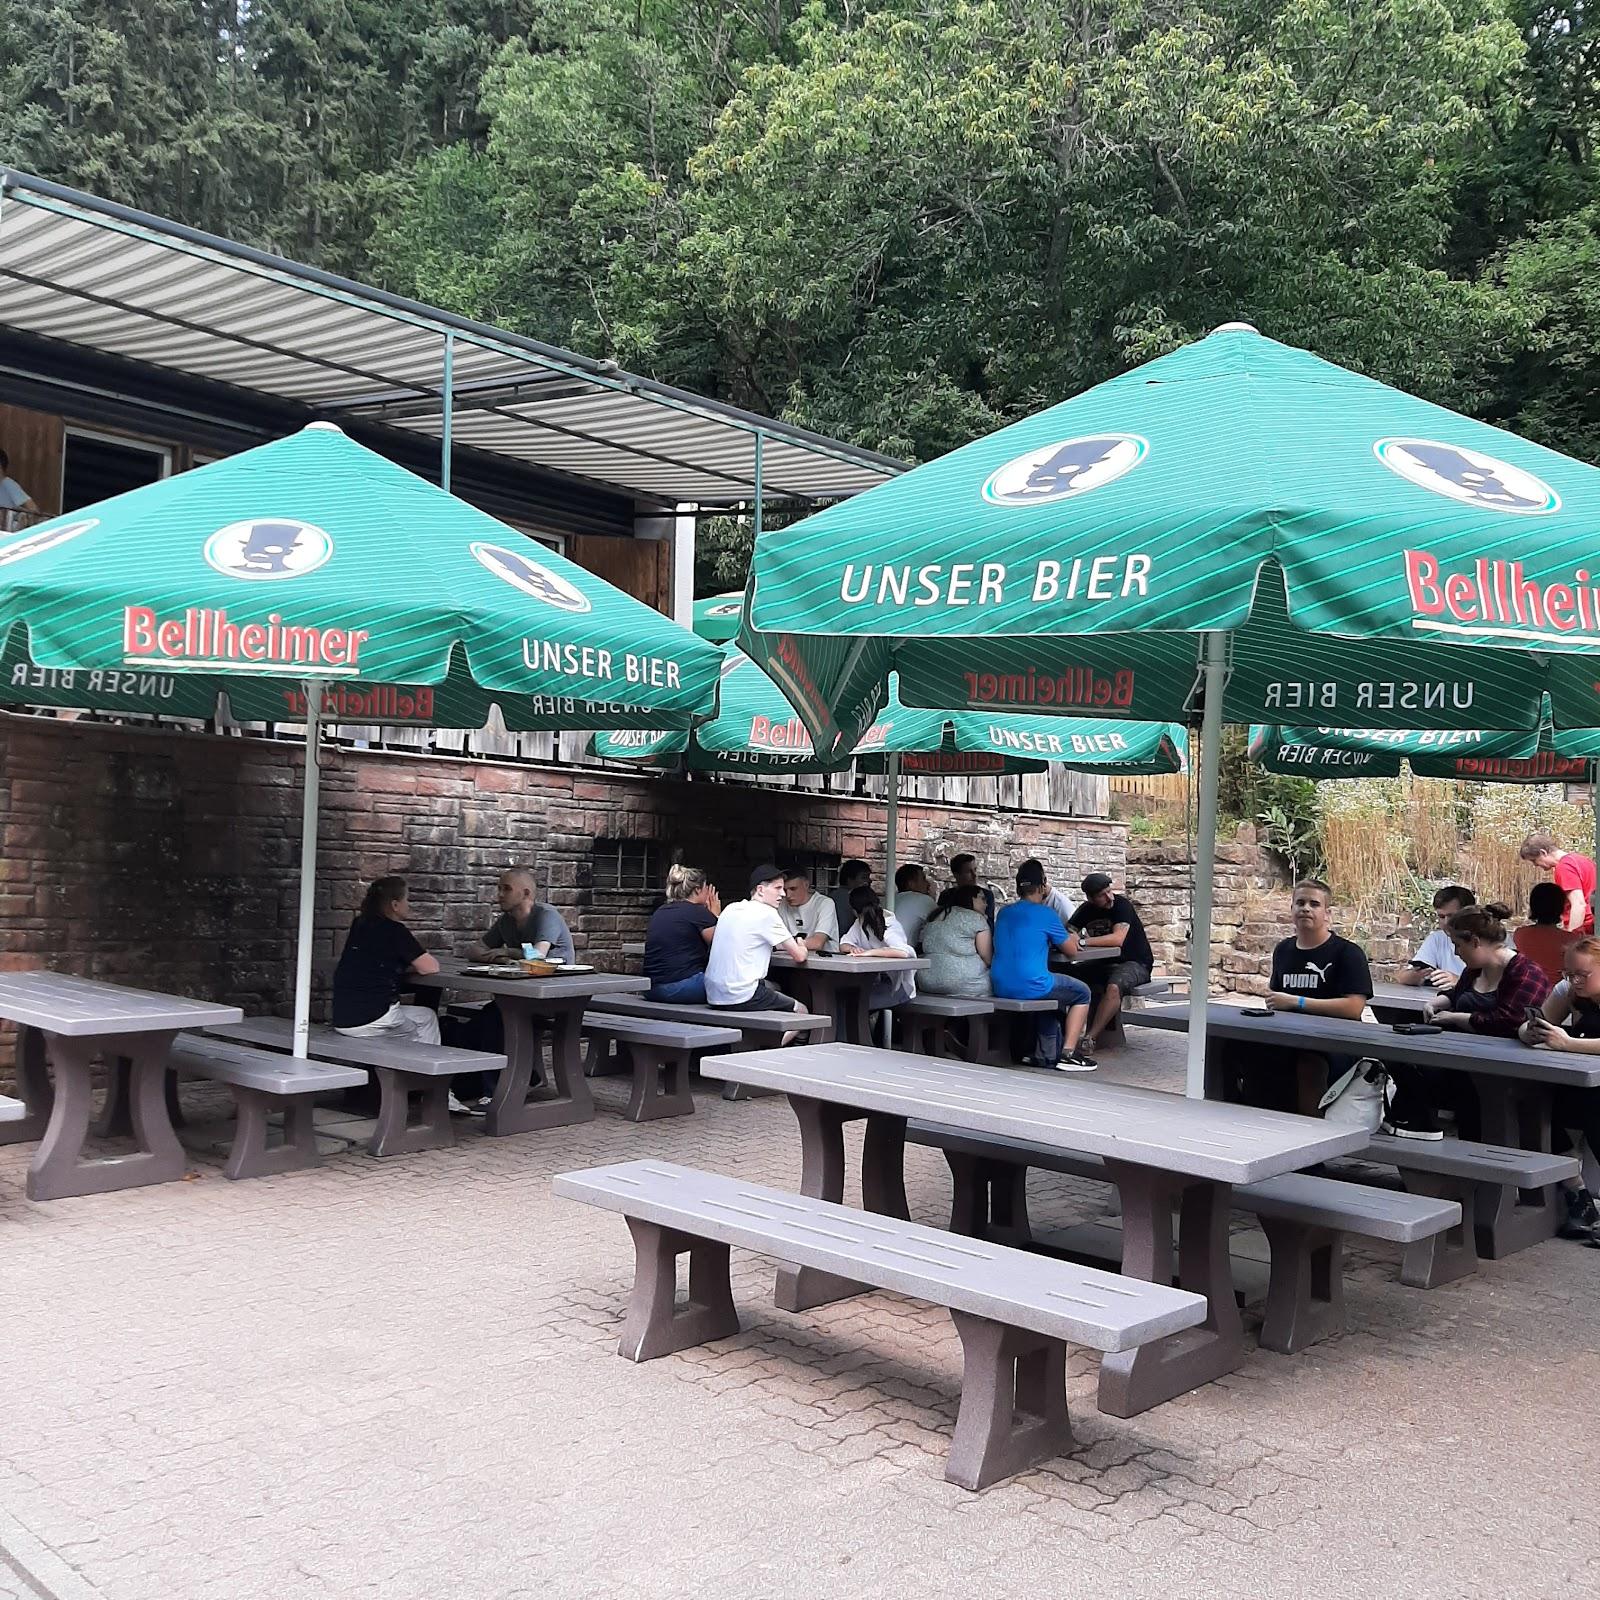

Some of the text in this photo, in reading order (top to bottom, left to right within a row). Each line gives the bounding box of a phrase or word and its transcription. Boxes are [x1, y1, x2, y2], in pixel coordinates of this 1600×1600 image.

[840, 554, 1151, 606] UNSER BIER
[1403, 549, 1600, 631] Bellhei
[123, 606, 369, 664] Bellheimer
[522, 638, 681, 689] UNSER BIER
[989, 725, 1128, 753] UNSER BIER
[1283, 973, 1319, 989] PUMA
